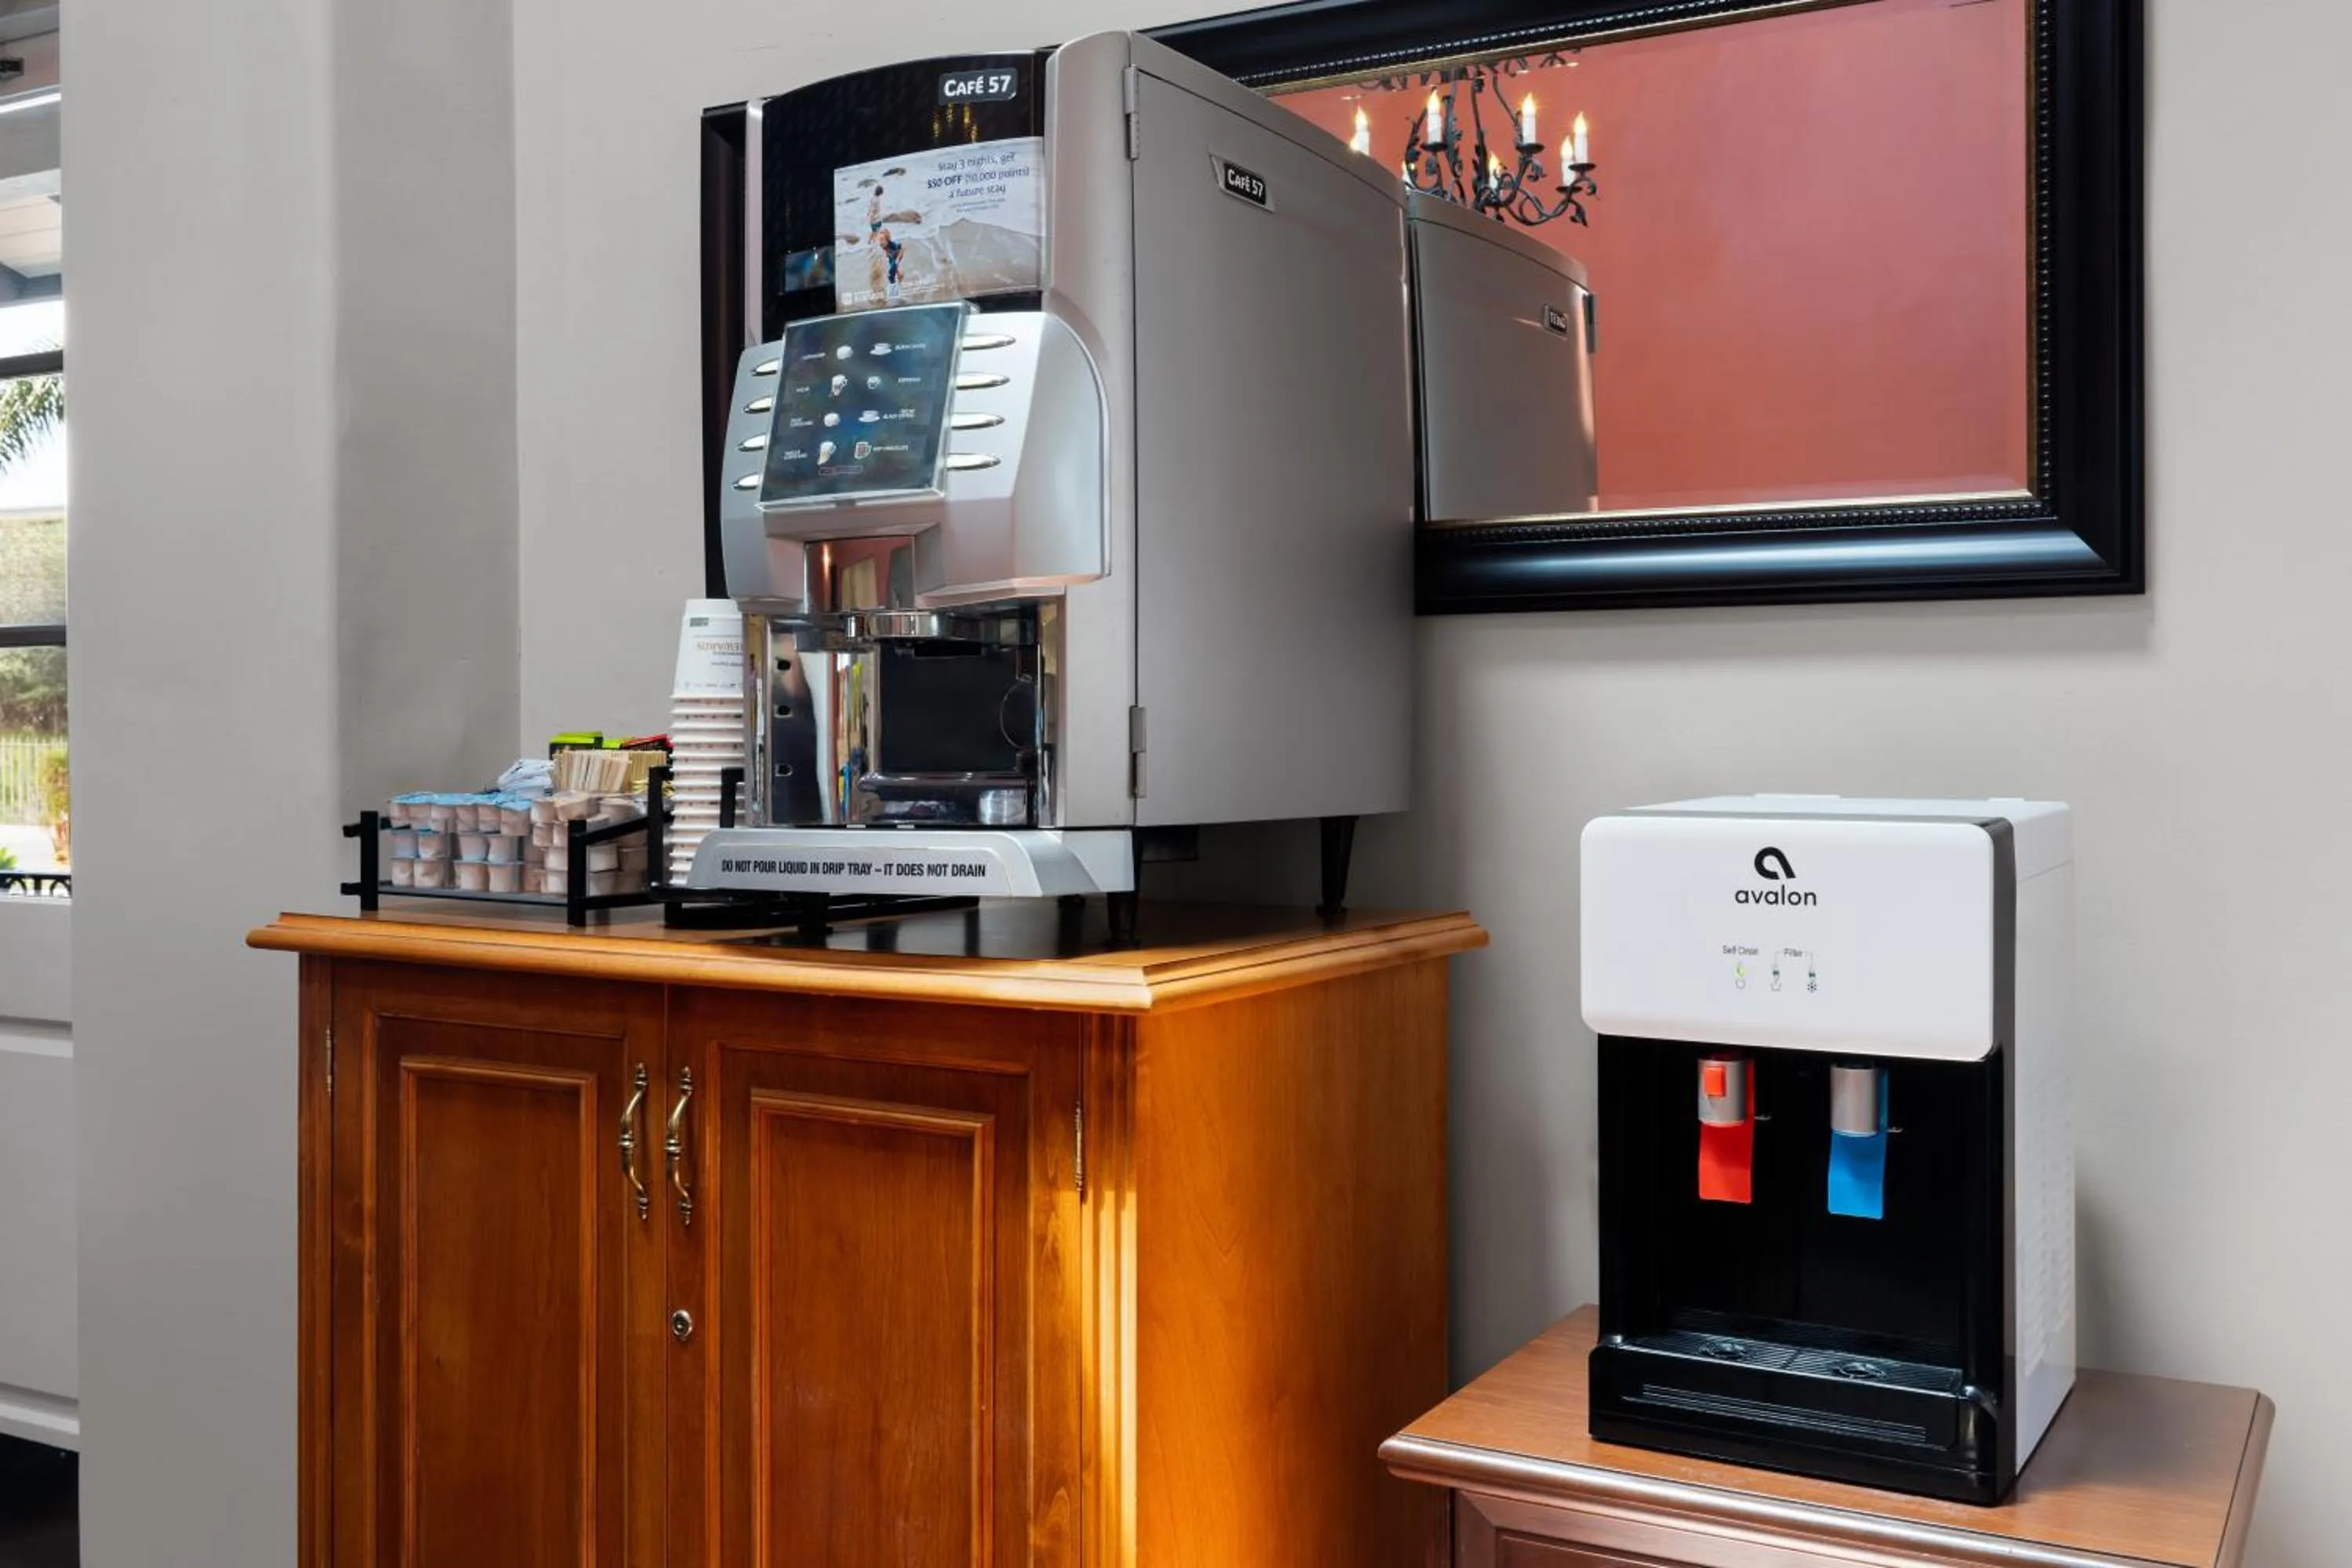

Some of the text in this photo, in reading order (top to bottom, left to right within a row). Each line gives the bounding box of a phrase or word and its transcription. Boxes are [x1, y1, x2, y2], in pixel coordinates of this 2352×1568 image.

[943, 74, 1011, 96] CAFÉ 57
[938, 160, 957, 172] Stay
[958, 159, 965, 170] 3
[1000, 152, 1016, 165] get
[927, 177, 942, 189] $50
[943, 174, 963, 187] OFF
[956, 187, 984, 198] future
[986, 183, 1006, 194] stay
[1252, 179, 1264, 198] 57
[721, 859, 733, 873] DO
[735, 860, 751, 873] NOT
[753, 860, 777, 873] POUR
[779, 861, 808, 874] LIQUID
[810, 862, 820, 874] IN
[822, 862, 845, 875] DRIP
[848, 862, 873, 876] TRAY
[884, 863, 894, 876] IT
[896, 863, 924, 877] DOES
[927, 863, 948, 877] NOT
[951, 864, 986, 877] DRAIN
[1735, 884, 1817, 906] avalon
